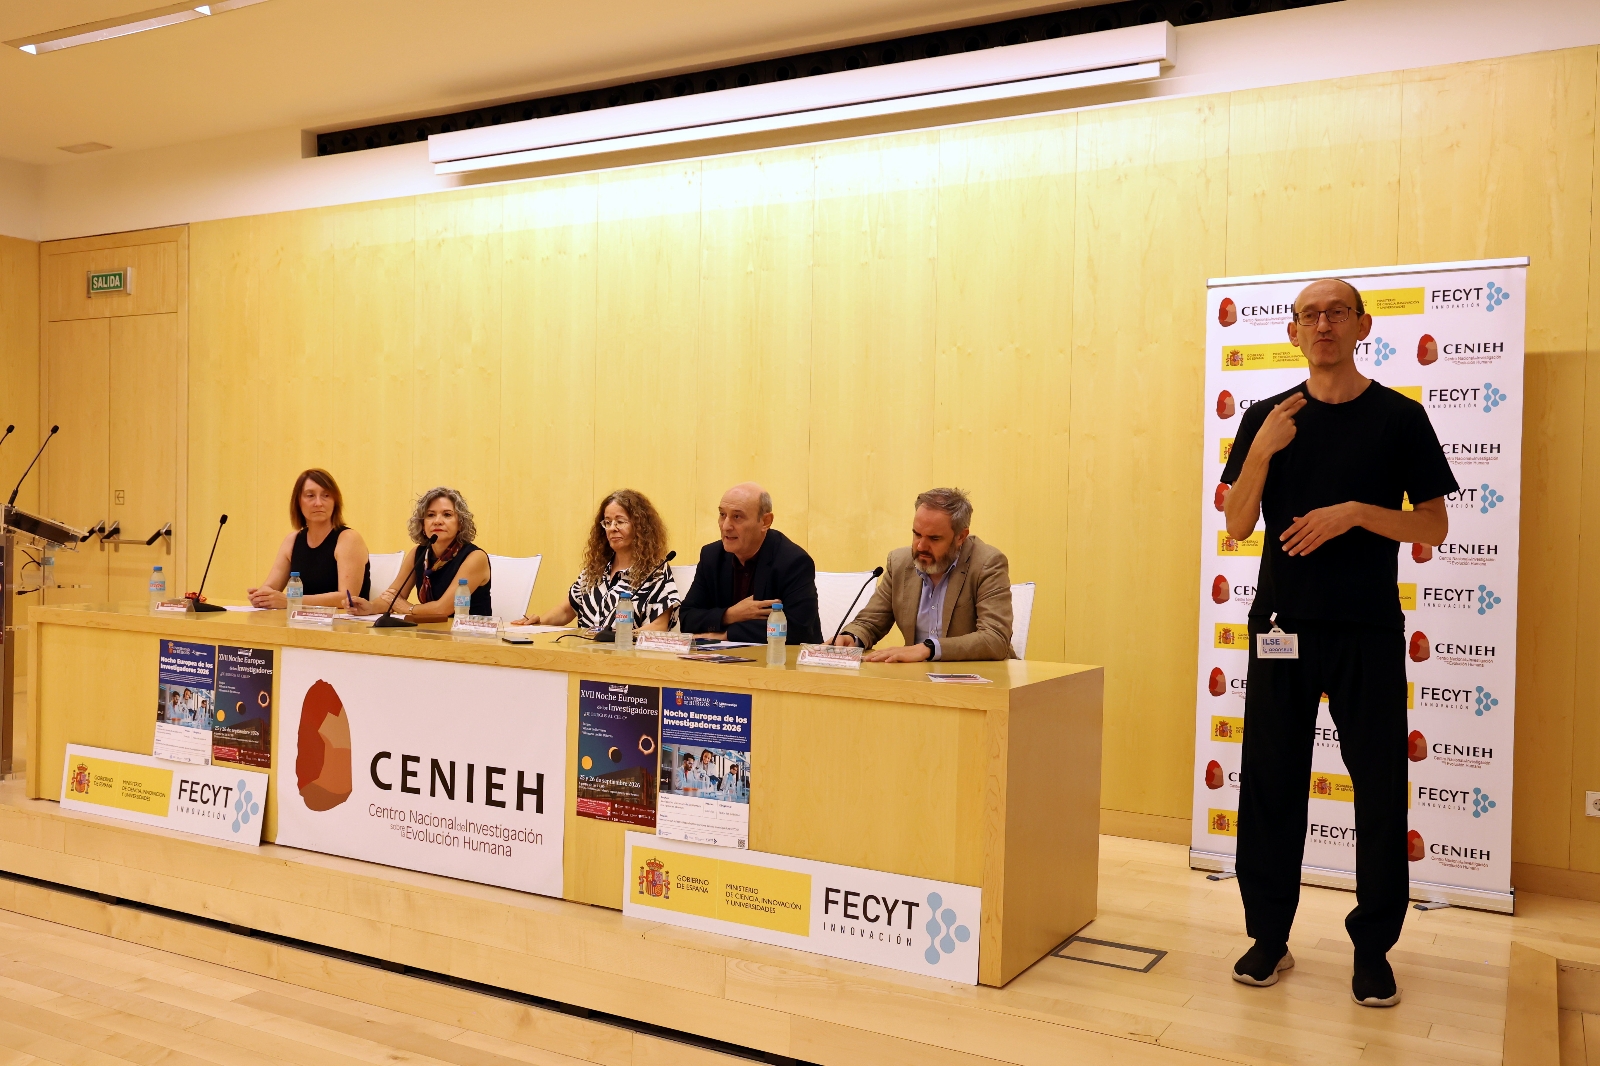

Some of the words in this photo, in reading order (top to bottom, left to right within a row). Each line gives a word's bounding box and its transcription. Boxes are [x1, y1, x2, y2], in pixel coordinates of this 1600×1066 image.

[93, 275, 120, 288] SALIDA
[1432, 288, 1483, 302] FECYT
[1242, 304, 1294, 316] CENIEH
[1443, 342, 1503, 354] CENIEH
[1429, 388, 1480, 401] FECYT
[1442, 444, 1500, 454] CENIEH
[1447, 489, 1477, 501] CYT
[1438, 544, 1498, 555] CENIEH
[1234, 586, 1257, 596] CEN
[1424, 588, 1474, 601] FECYT
[1435, 643, 1495, 656] CENIEH
[244, 657, 265, 665] Europea
[161, 663, 196, 673] Investigadores
[238, 665, 273, 674] Investigadores
[581, 689, 594, 698] XVII
[596, 692, 616, 701] Noche
[618, 694, 648, 705] Europea
[1421, 687, 1472, 702] FECYT
[609, 704, 658, 716] Investigadores
[664, 709, 688, 718] Noche
[690, 712, 722, 721] Europea
[664, 718, 720, 730] Investigadores
[722, 724, 741, 732] 2026
[1314, 727, 1340, 741] FEC
[1433, 743, 1492, 758] CENIEH
[370, 751, 544, 814] CENIEH
[602, 779, 627, 787] septiembre
[178, 779, 233, 808] FECYT
[1418, 787, 1469, 804] FECYT
[176, 805, 227, 820] INNOVACIÓN
[368, 803, 406, 822] Centro
[410, 810, 456, 830] Nacional
[457, 823, 465, 832] de
[466, 819, 543, 845] Investigación
[1311, 824, 1356, 840] FECYT
[406, 826, 459, 847] Evolución
[464, 835, 512, 857] Humana
[1430, 843, 1490, 860] CENIEH
[677, 875, 709, 886] GOBIERNO
[686, 883, 709, 894] ESPAÑA
[726, 884, 759, 894] MINISTERIO
[730, 900, 776, 913] UNIVERSIDADES
[761, 897, 802, 910] INNOVACIÓN
[824, 887, 919, 930] FECYT
[824, 922, 912, 946] INNOVACIÓN
